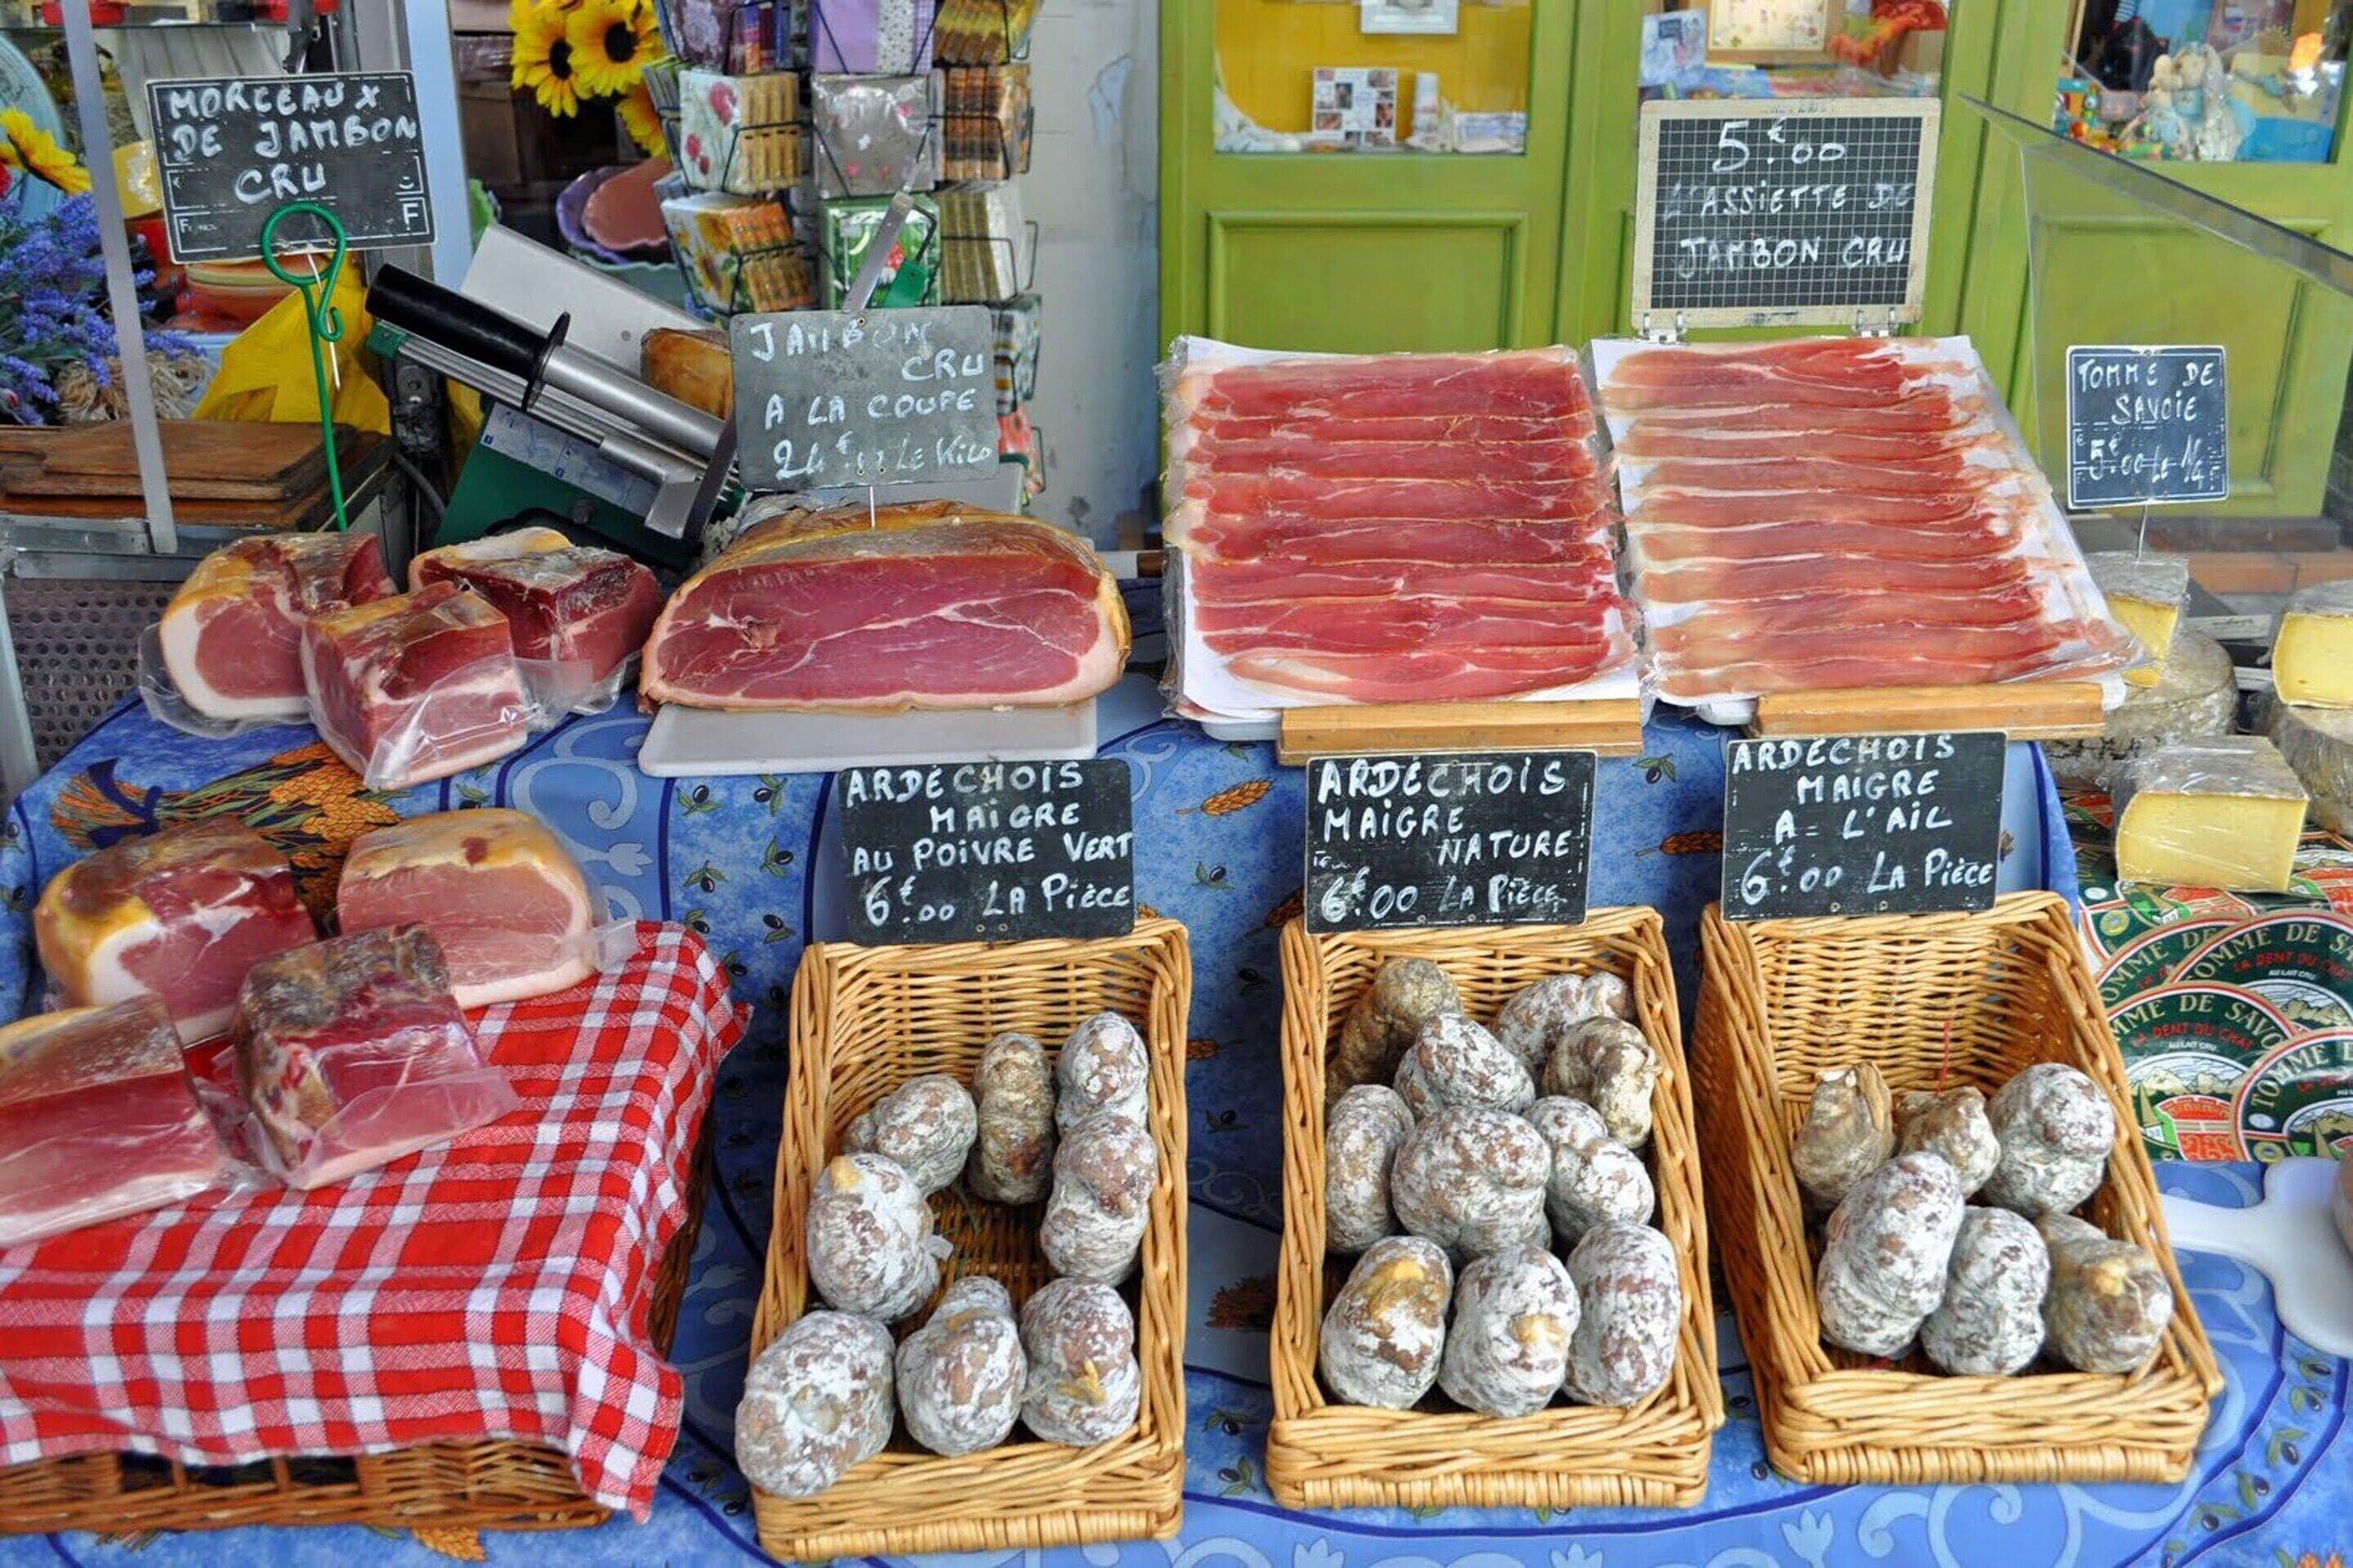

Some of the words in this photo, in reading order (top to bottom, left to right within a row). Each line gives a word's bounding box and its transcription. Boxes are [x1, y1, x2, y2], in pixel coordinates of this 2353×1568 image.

[169, 81, 381, 119] MORCEAUX
[171, 124, 223, 163] DE
[254, 114, 417, 159] JAMBON
[234, 163, 327, 204] CRU
[1842, 235, 1908, 269] CRU
[901, 347, 985, 382] CRU
[2078, 358, 2159, 392] TOMME
[2182, 361, 2215, 386] DE
[807, 394, 846, 426] LA
[852, 847, 894, 877] AU
[1062, 831, 1133, 863] VERT
[1437, 829, 1573, 867] NATURE
[1866, 850, 1906, 895] LA
[982, 879, 1027, 917] LA
[1438, 873, 1476, 913] LA
[2100, 941, 2169, 1002] OMME
[2187, 927, 2272, 981] OMME
[2285, 923, 2321, 944] DE
[2110, 999, 2165, 1041] MME
[2179, 994, 2215, 1013] DE
[2225, 1001, 2284, 1051] SAVO
[2251, 1043, 2329, 1110] TOMME
